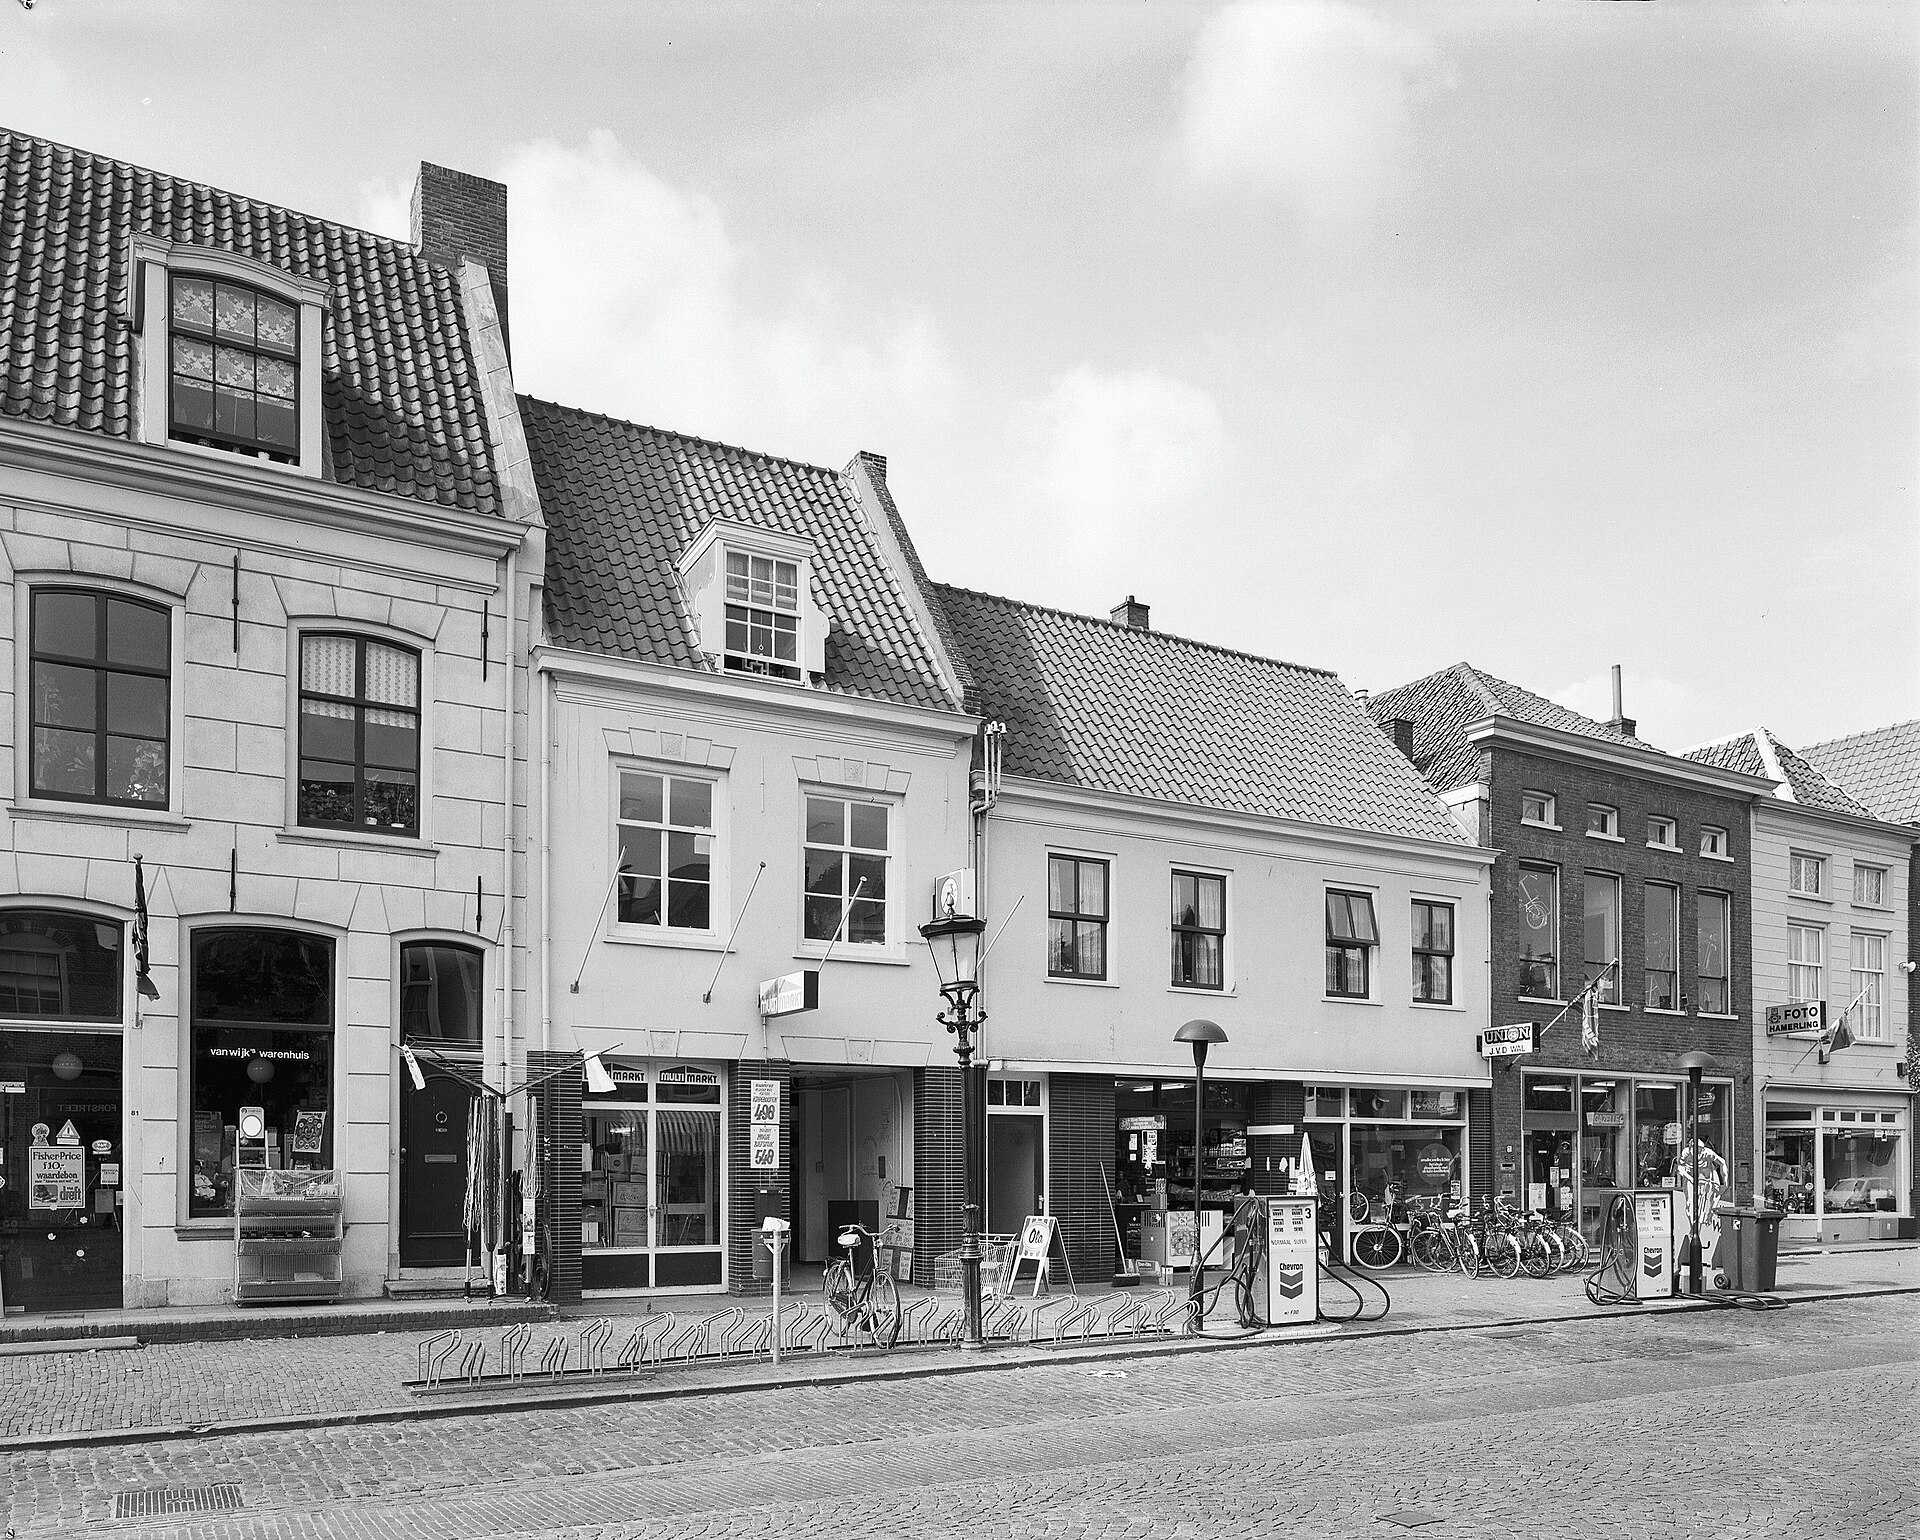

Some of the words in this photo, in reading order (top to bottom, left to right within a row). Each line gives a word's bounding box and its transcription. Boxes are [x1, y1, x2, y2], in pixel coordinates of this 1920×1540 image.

[1784, 1006, 1818, 1020] FOTO
[1769, 1020, 1818, 1032] HAMERLING
[1484, 1025, 1531, 1044] UNION
[210, 1048, 228, 1056] van
[259, 1050, 310, 1060] warenhuis
[1510, 1045, 1525, 1053] WAL
[612, 1071, 645, 1081] MARKT
[661, 1072, 684, 1082] MULTI
[686, 1073, 717, 1084] MARKT
[754, 1103, 776, 1121] 498
[754, 1148, 775, 1165] 548
[1661, 1199, 1667, 1209] 1
[1304, 1207, 1312, 1219] 3
[1028, 1227, 1043, 1244] Ola
[1643, 1246, 1663, 1254] Chevron
[1279, 1262, 1304, 1271] Chevron
